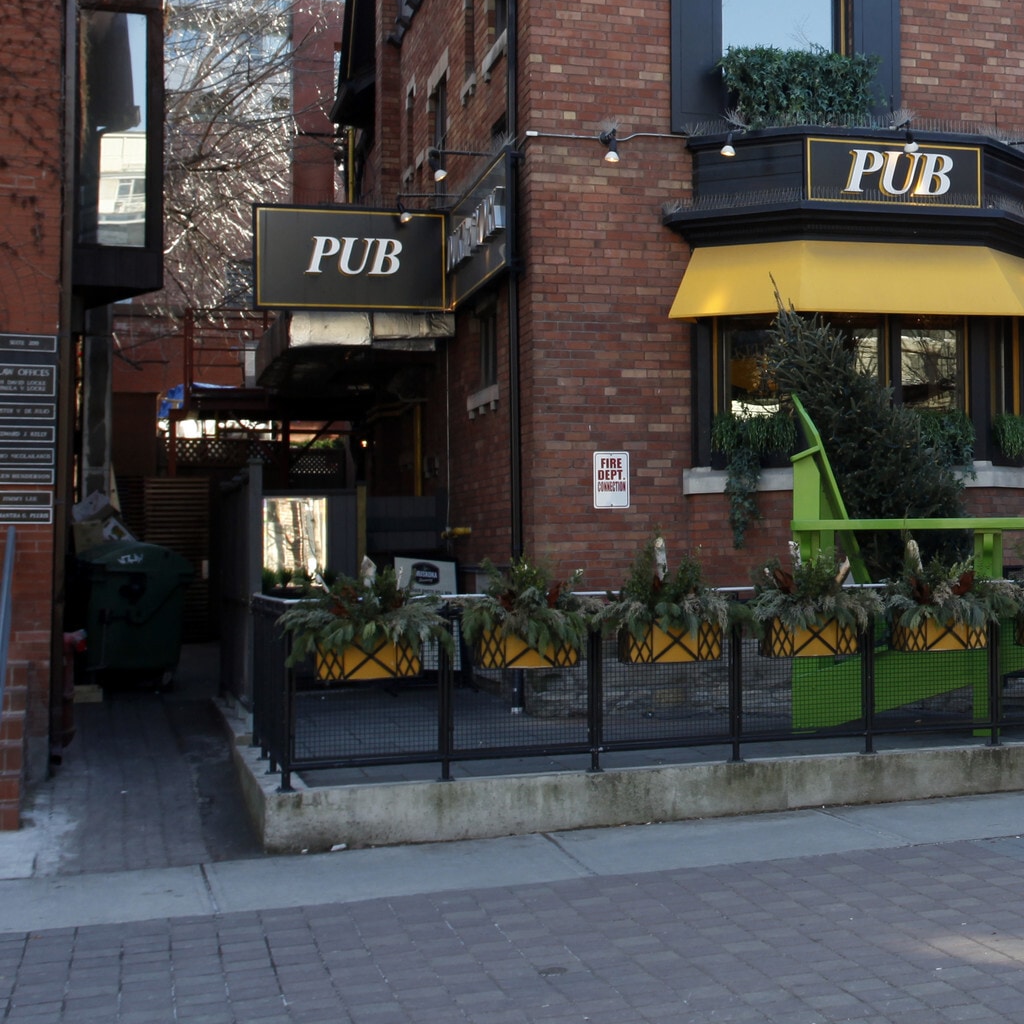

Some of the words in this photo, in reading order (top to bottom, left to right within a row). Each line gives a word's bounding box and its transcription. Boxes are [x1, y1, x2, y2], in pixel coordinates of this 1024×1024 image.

[841, 148, 954, 198] PUB
[303, 235, 404, 276] PUB
[17, 368, 50, 377] OFFICES
[600, 458, 622, 469] FIRE
[597, 469, 626, 481] DEPT.
[597, 481, 627, 492] CONNECTION
